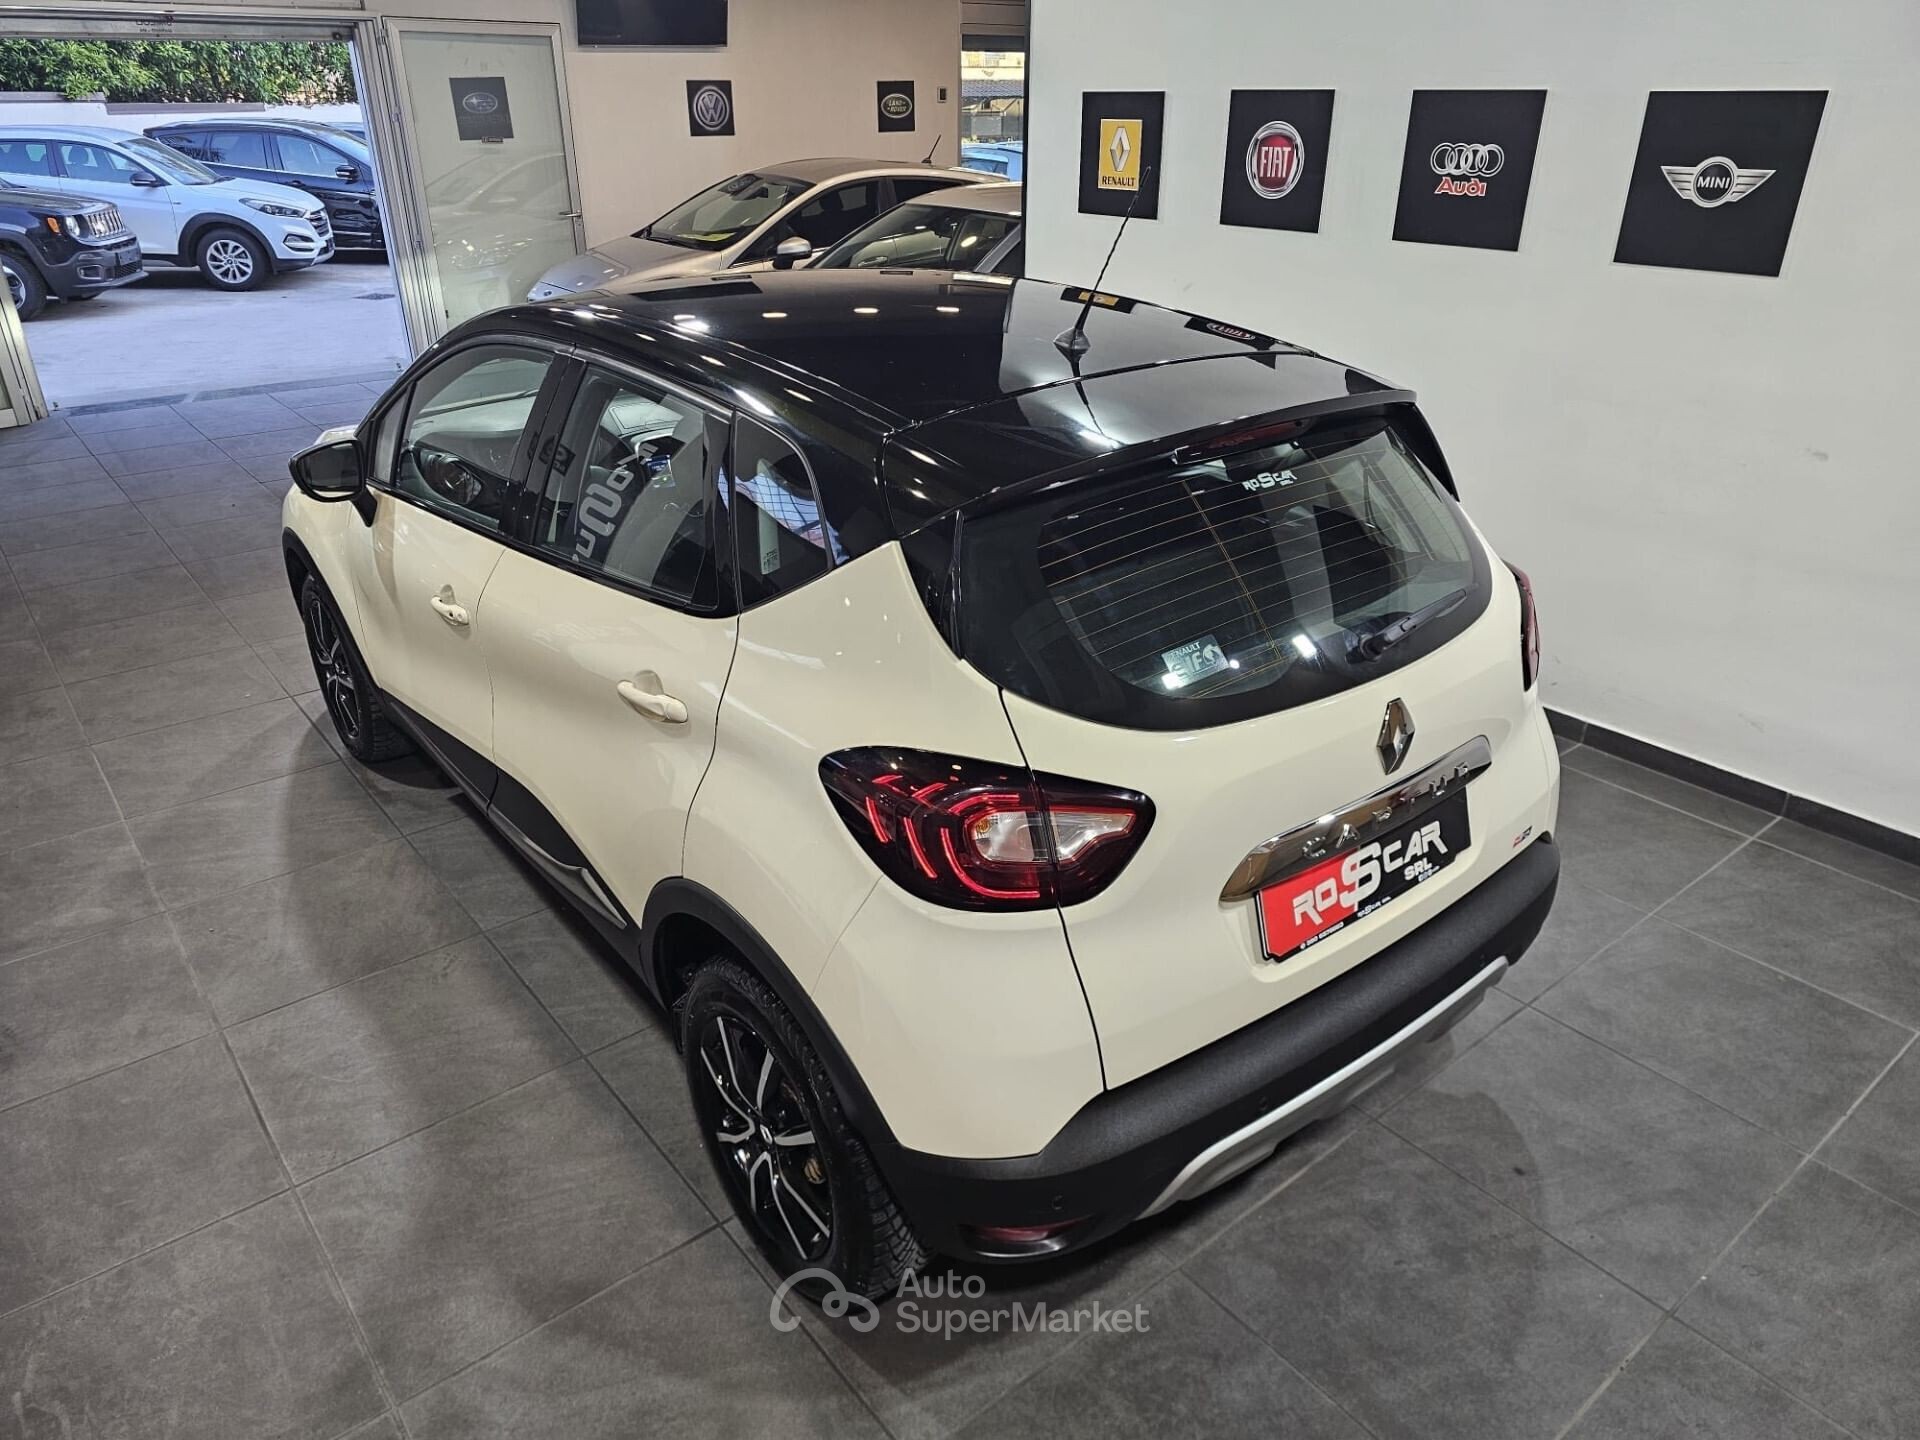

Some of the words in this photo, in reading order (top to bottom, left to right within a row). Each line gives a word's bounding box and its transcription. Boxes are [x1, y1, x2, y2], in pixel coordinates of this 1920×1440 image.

[1261, 147, 1291, 177] FIAT
[1102, 176, 1135, 186] RENAULT
[1434, 177, 1487, 197] Audi
[1697, 176, 1730, 189] MINI
[1404, 858, 1433, 881] SRL
